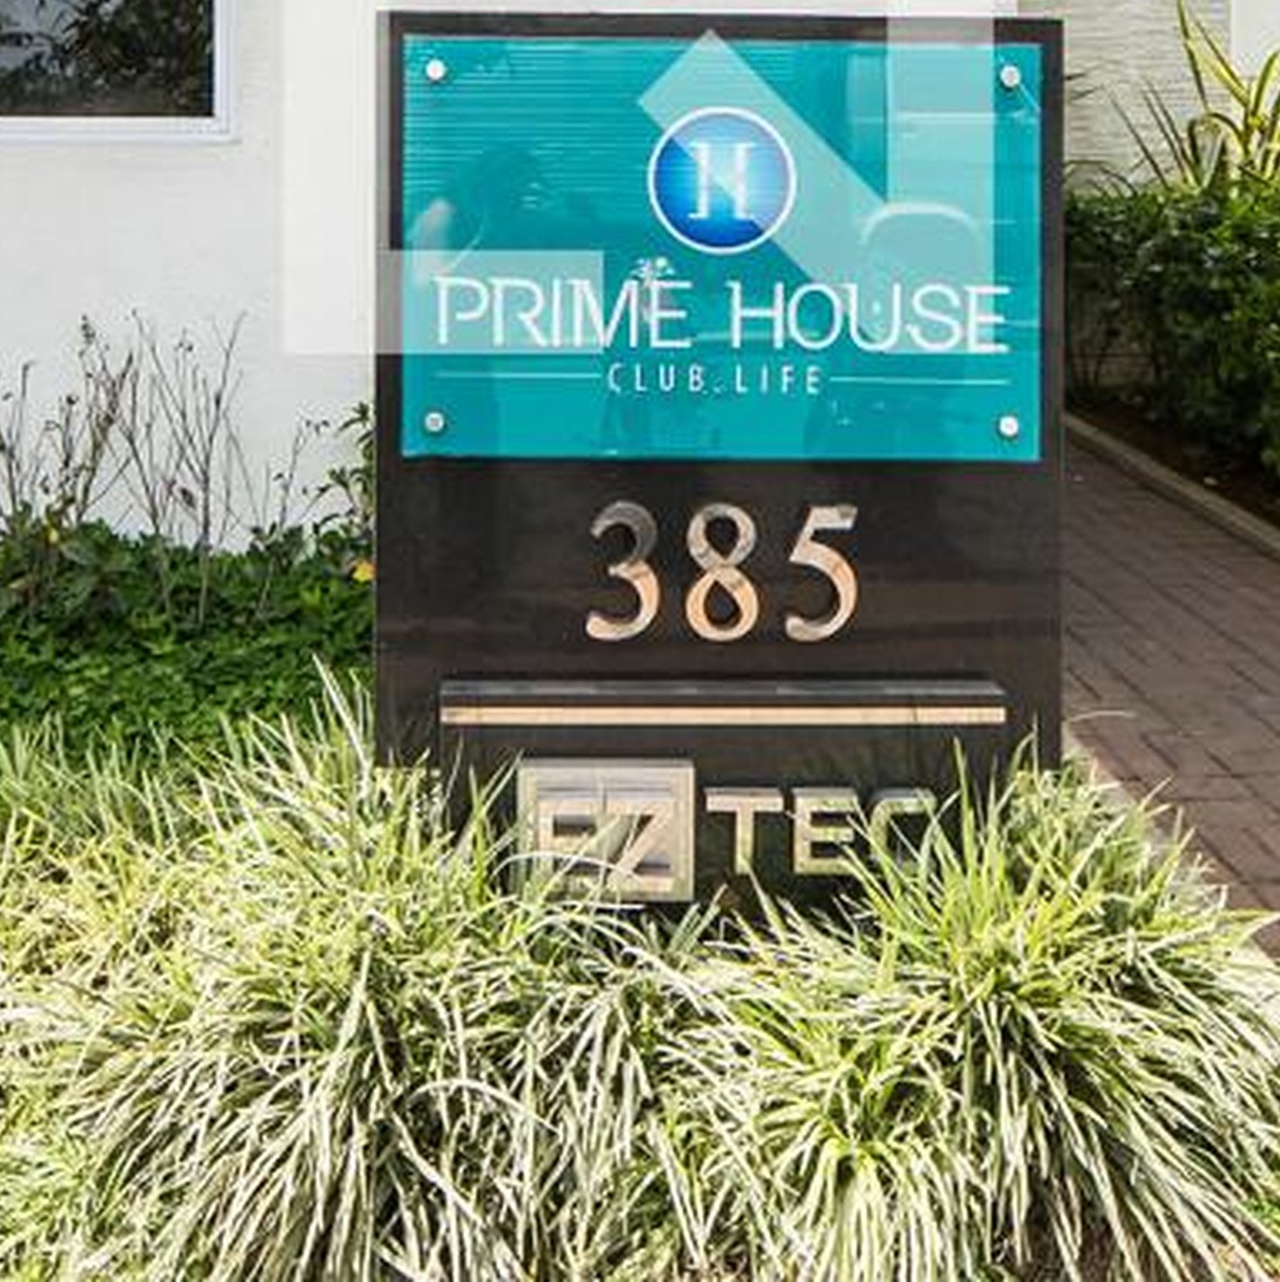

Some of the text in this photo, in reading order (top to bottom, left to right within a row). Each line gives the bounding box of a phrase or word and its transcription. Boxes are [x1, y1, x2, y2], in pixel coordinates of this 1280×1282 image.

[434, 276, 1011, 355] PRIME HOUSE
[586, 500, 859, 642] 385
